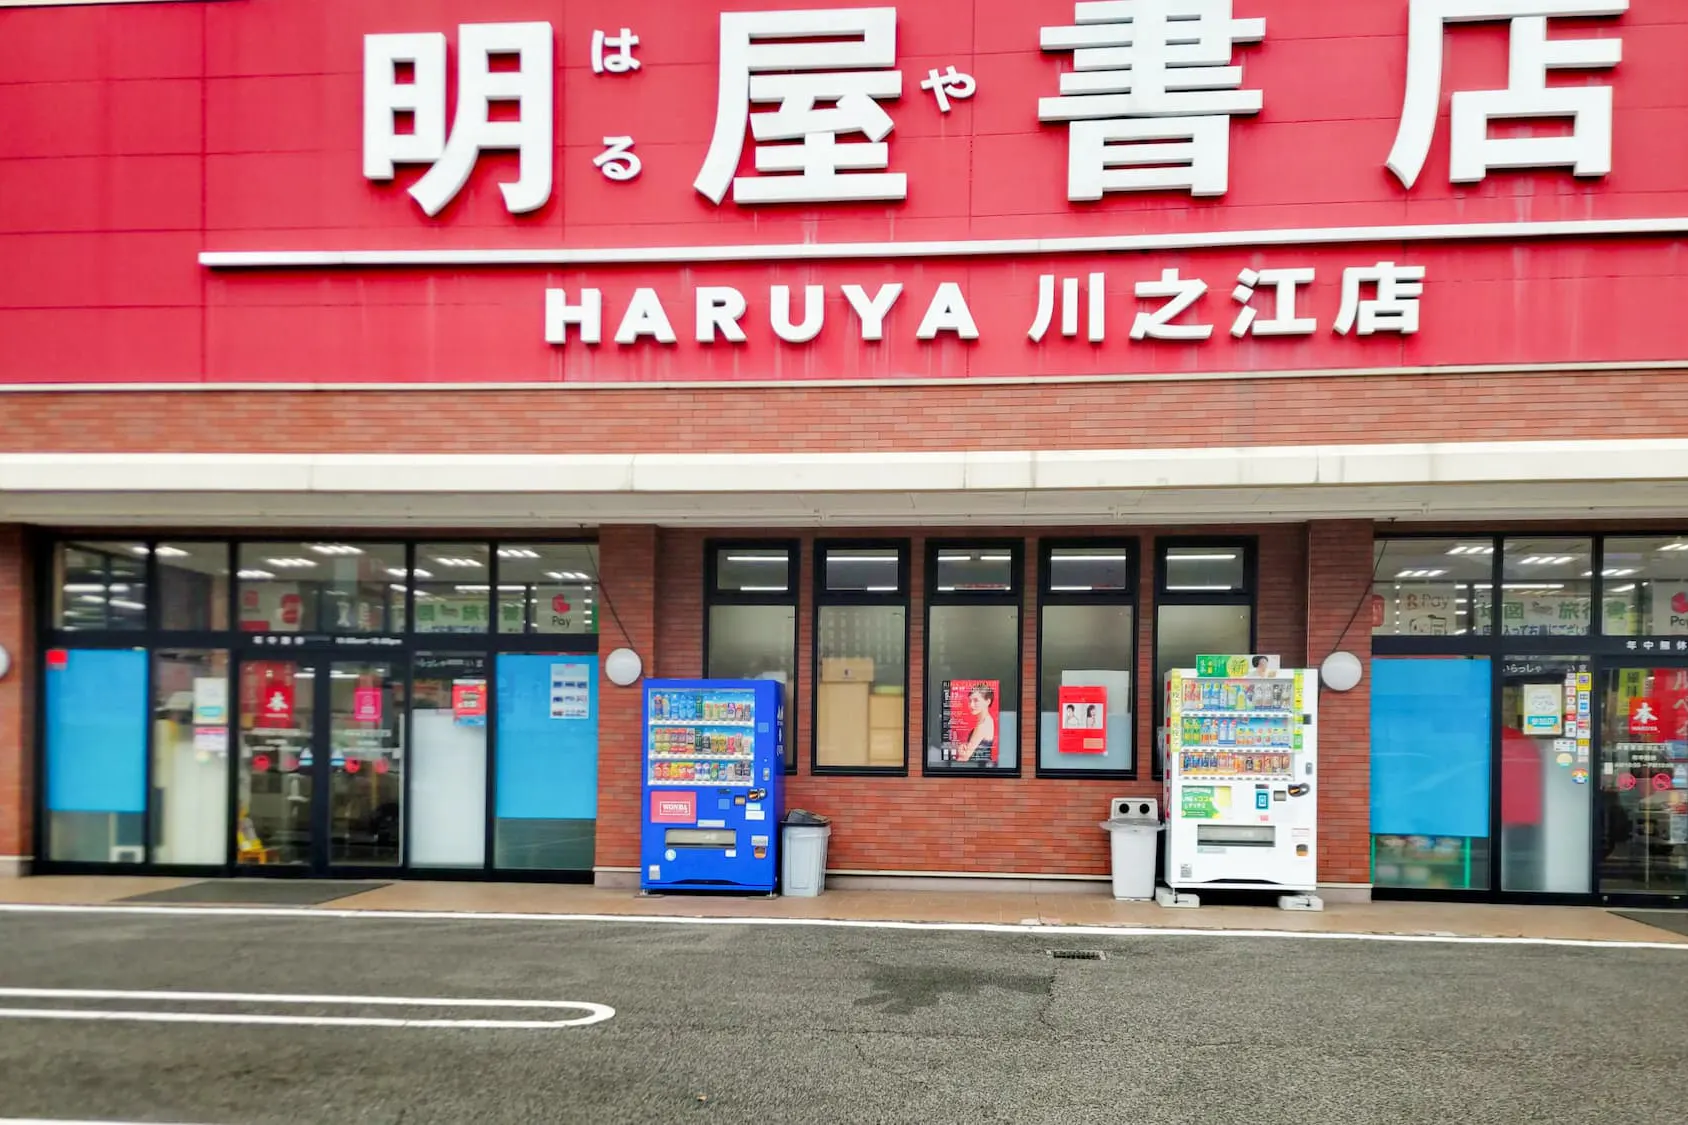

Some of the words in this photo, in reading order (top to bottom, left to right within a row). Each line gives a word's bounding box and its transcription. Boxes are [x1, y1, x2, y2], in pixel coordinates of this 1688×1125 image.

[920, 66, 977, 113] や
[544, 282, 980, 346] HARUYA
[1027, 261, 1426, 344] 川之江店
[551, 615, 572, 627] Pay
[1626, 640, 1688, 651] 年中無休
[1632, 702, 1659, 724] 本
